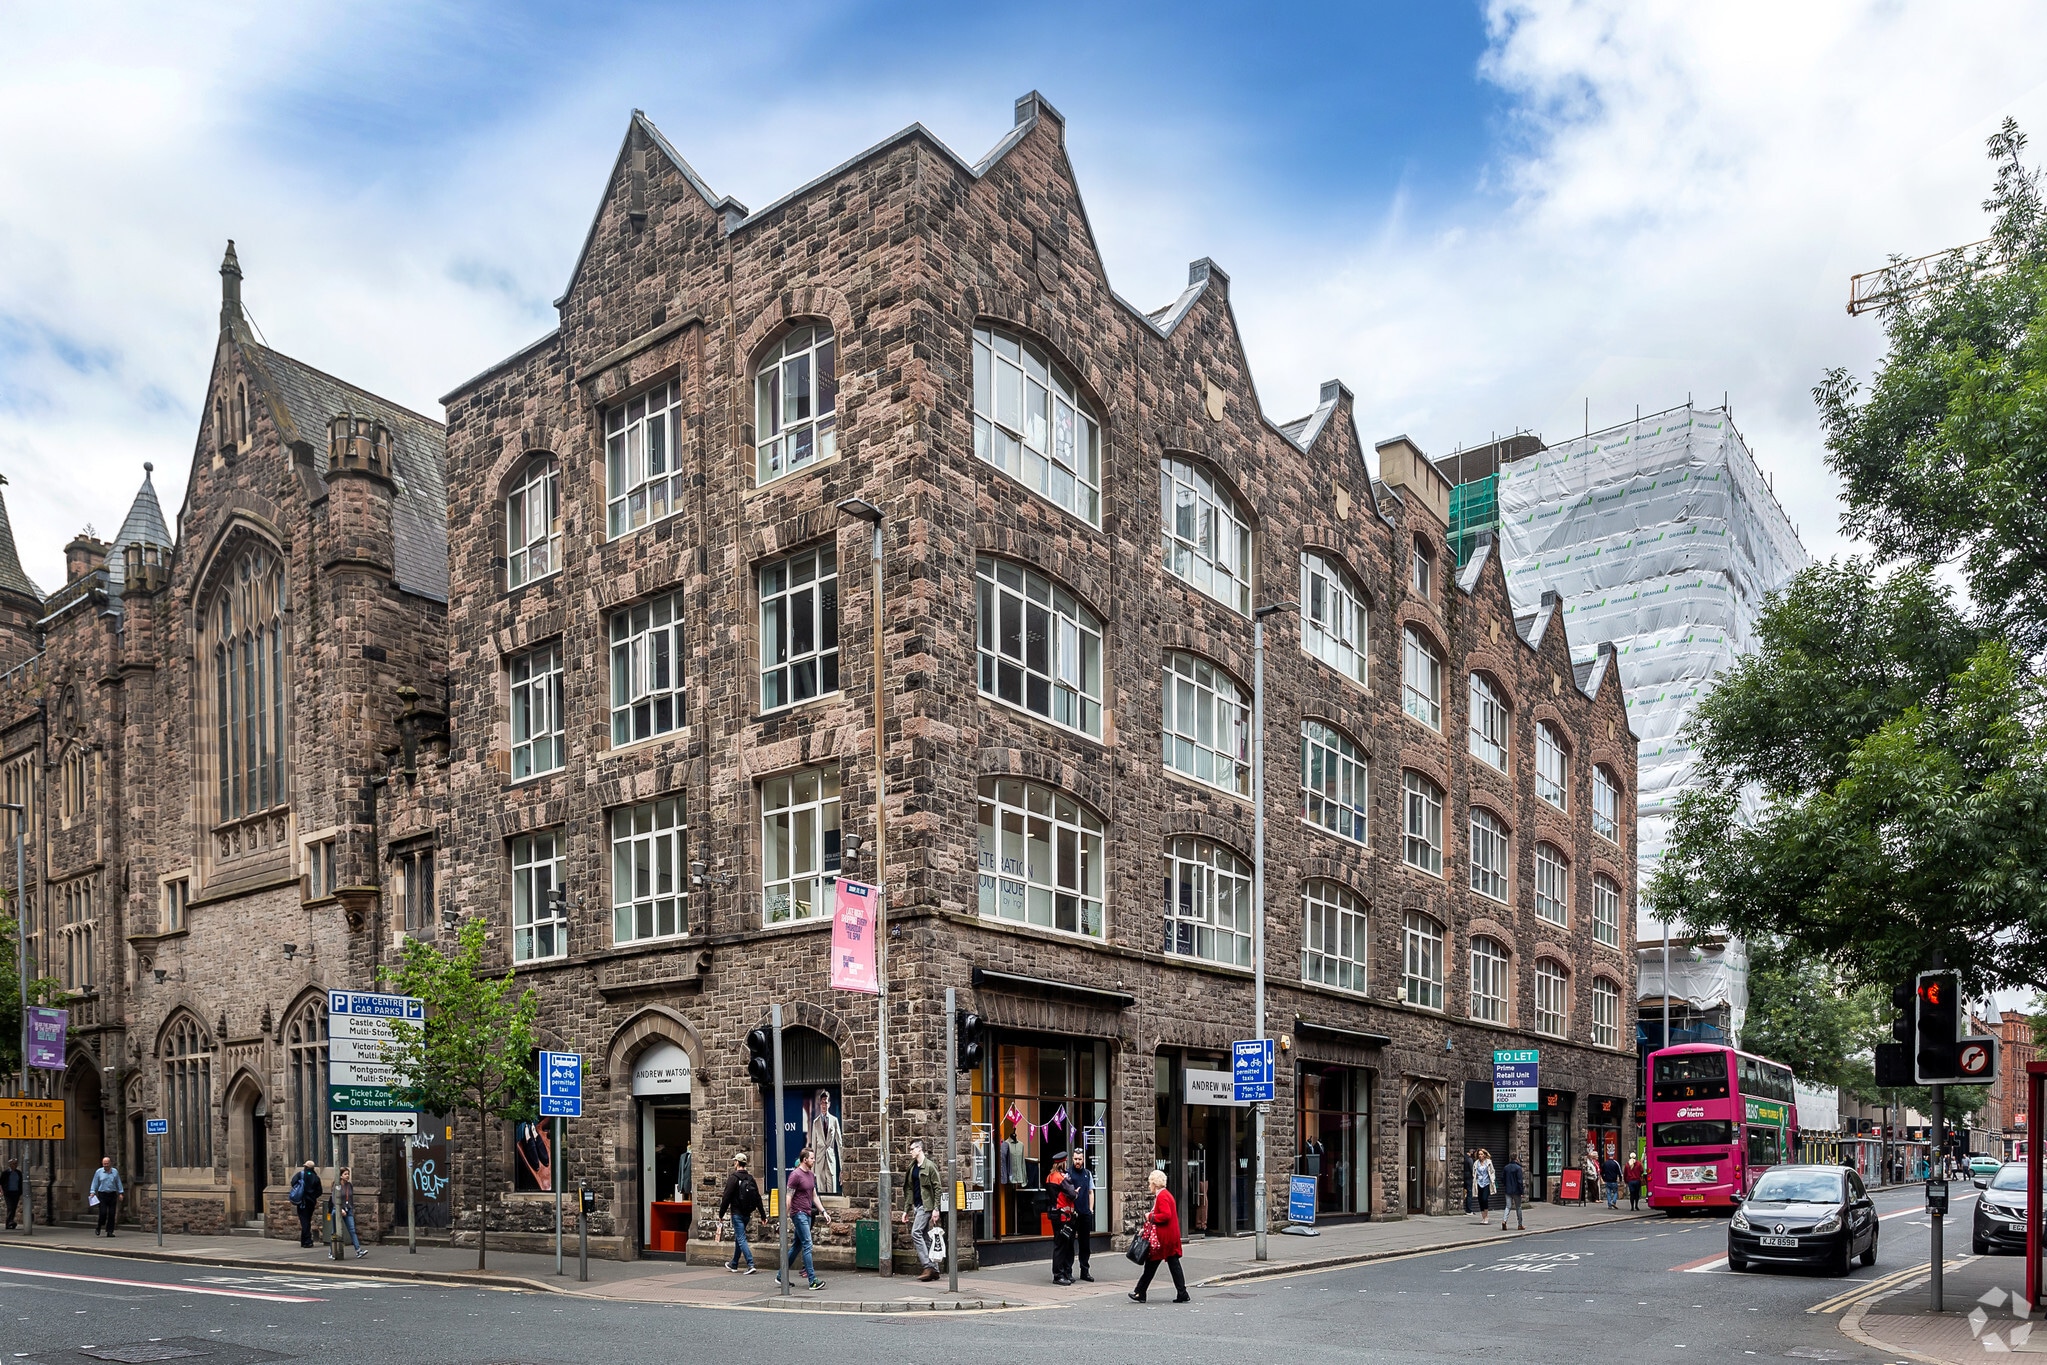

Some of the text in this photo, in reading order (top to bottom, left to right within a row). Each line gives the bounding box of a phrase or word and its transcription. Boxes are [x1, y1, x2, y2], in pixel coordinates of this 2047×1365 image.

[1667, 422, 1689, 432] GRAHAM
[1634, 432, 1657, 441] GRAHAM
[1604, 441, 1625, 451] GRAHAM
[1573, 450, 1594, 459] GRAHAM
[1543, 459, 1564, 468] GRAHAM
[1516, 468, 1535, 478] GRAHAM
[1662, 478, 1684, 487] GRAHAM
[1629, 486, 1651, 495] GRAHAM
[1598, 495, 1619, 503] GRAHAM
[1567, 502, 1588, 511] GRAHAM
[1538, 510, 1558, 519] GRAHAM
[1669, 530, 1692, 539] GRAHAM
[1637, 537, 1659, 546] GRAHAM
[1605, 545, 1627, 554] GRAHAM
[1575, 552, 1596, 561] GRAHAM
[1545, 560, 1566, 568] GRAHAM
[1516, 567, 1535, 575] GRAHAM
[1642, 589, 1664, 598] GRAHAM
[1611, 596, 1633, 605] GRAHAM
[1580, 603, 1602, 612] GRAHAM
[1634, 645, 1656, 653] GRAHAM
[1639, 698, 1660, 706] GRAHAM
[335, 996, 345, 1010] P
[352, 997, 403, 1007] CITY CENTRE
[356, 1005, 400, 1015] CAR PARKS
[350, 1019, 390, 1028] Castle Cou
[1497, 1053, 1533, 1061] TO LET
[637, 1068, 691, 1078] ANDREW WATSON
[356, 1075, 403, 1084] Multi-Storey
[1192, 1081, 1220, 1092] ANDREW
[389, 1100, 414, 1108] Prking
[350, 1119, 398, 1127] Shopmobility
